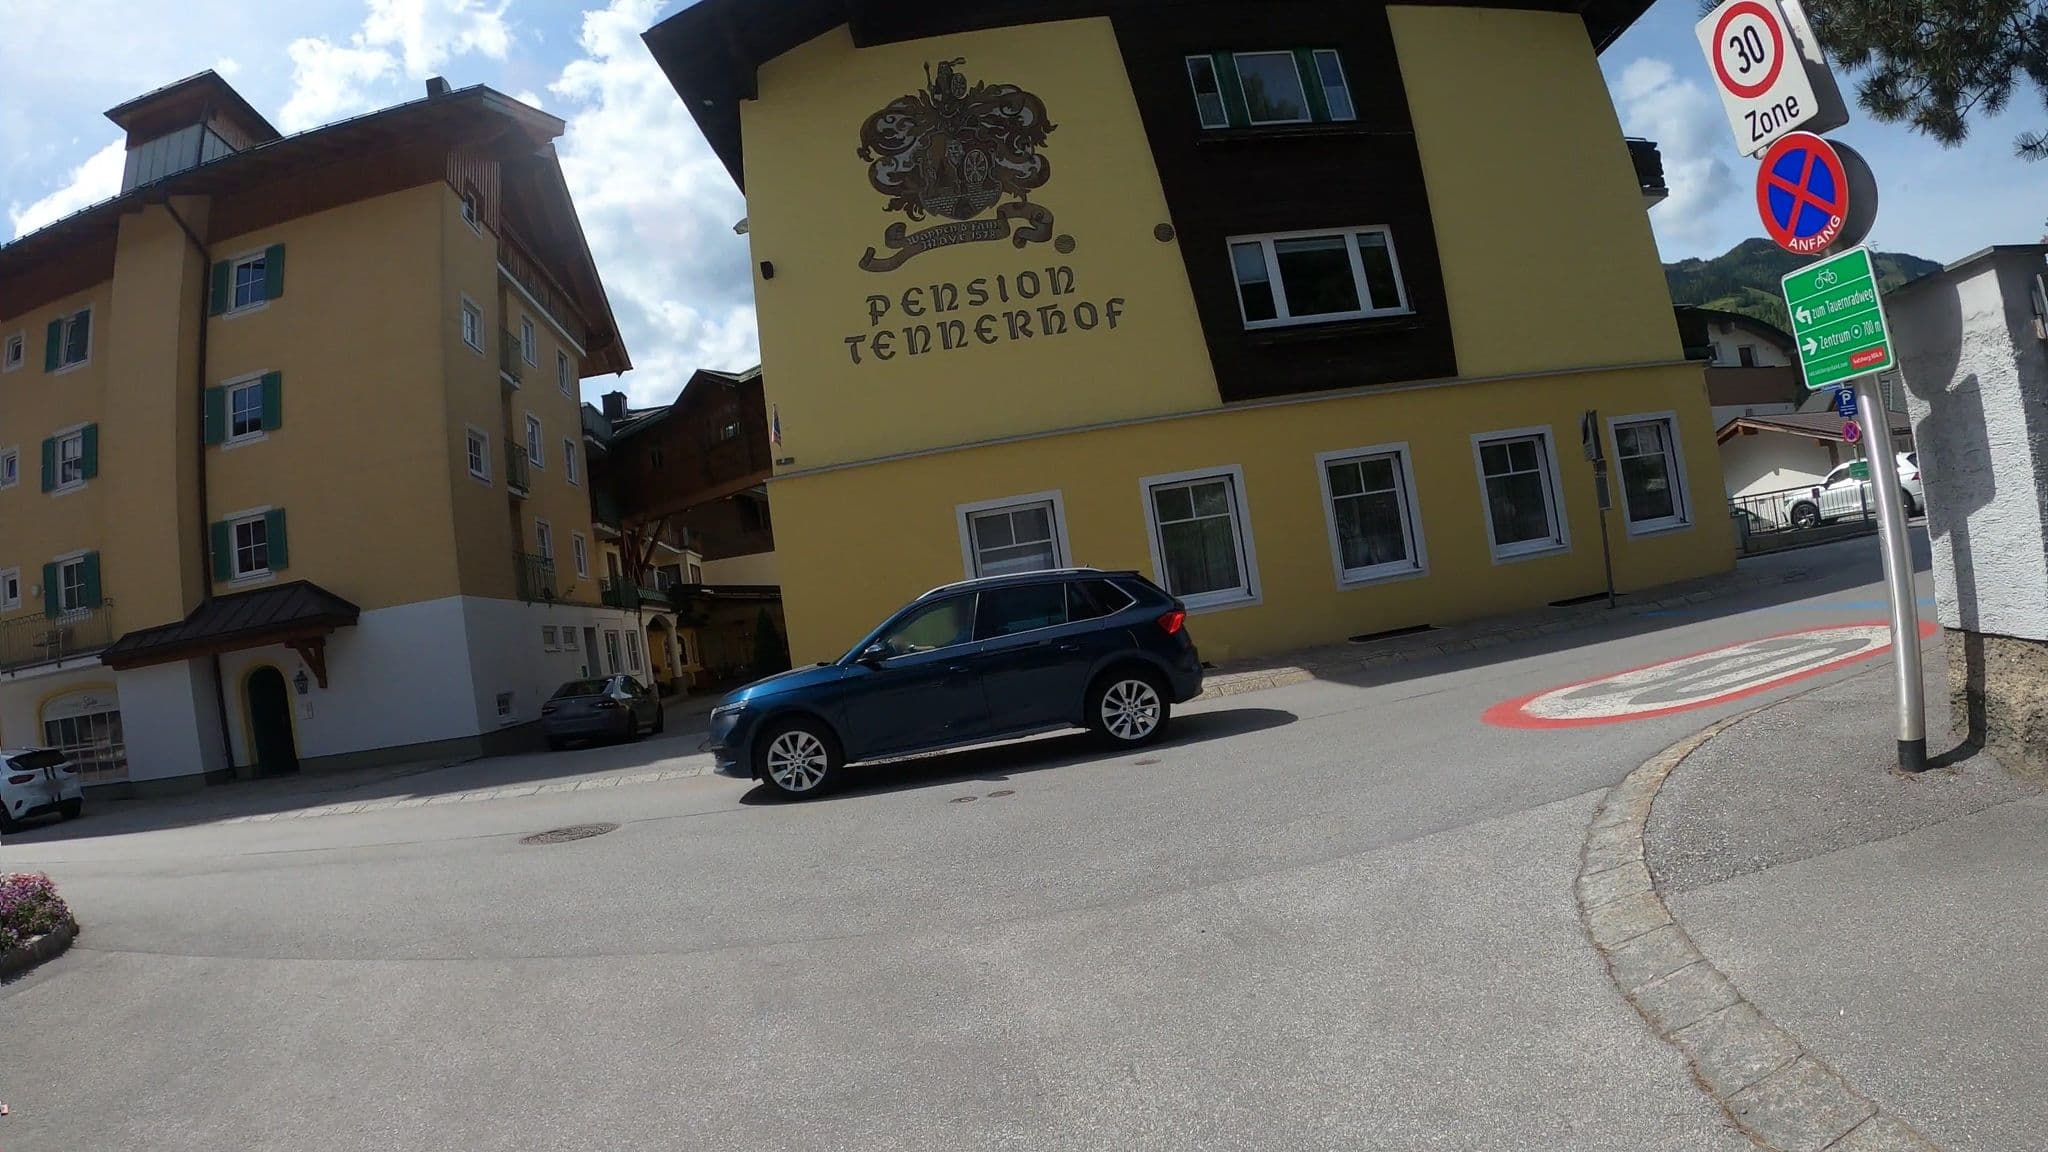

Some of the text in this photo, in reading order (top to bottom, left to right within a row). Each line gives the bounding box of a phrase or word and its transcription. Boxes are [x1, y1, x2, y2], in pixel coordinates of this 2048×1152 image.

[1729, 25, 1765, 74] 30
[1744, 95, 1800, 142] Zone
[1788, 214, 1841, 251] ANFANG
[866, 266, 1075, 326] PENSION
[1812, 289, 1874, 319] zum Tauernradweg
[844, 298, 1125, 365] TENNERHOF
[1819, 320, 1881, 349] Zentrum 700 m
